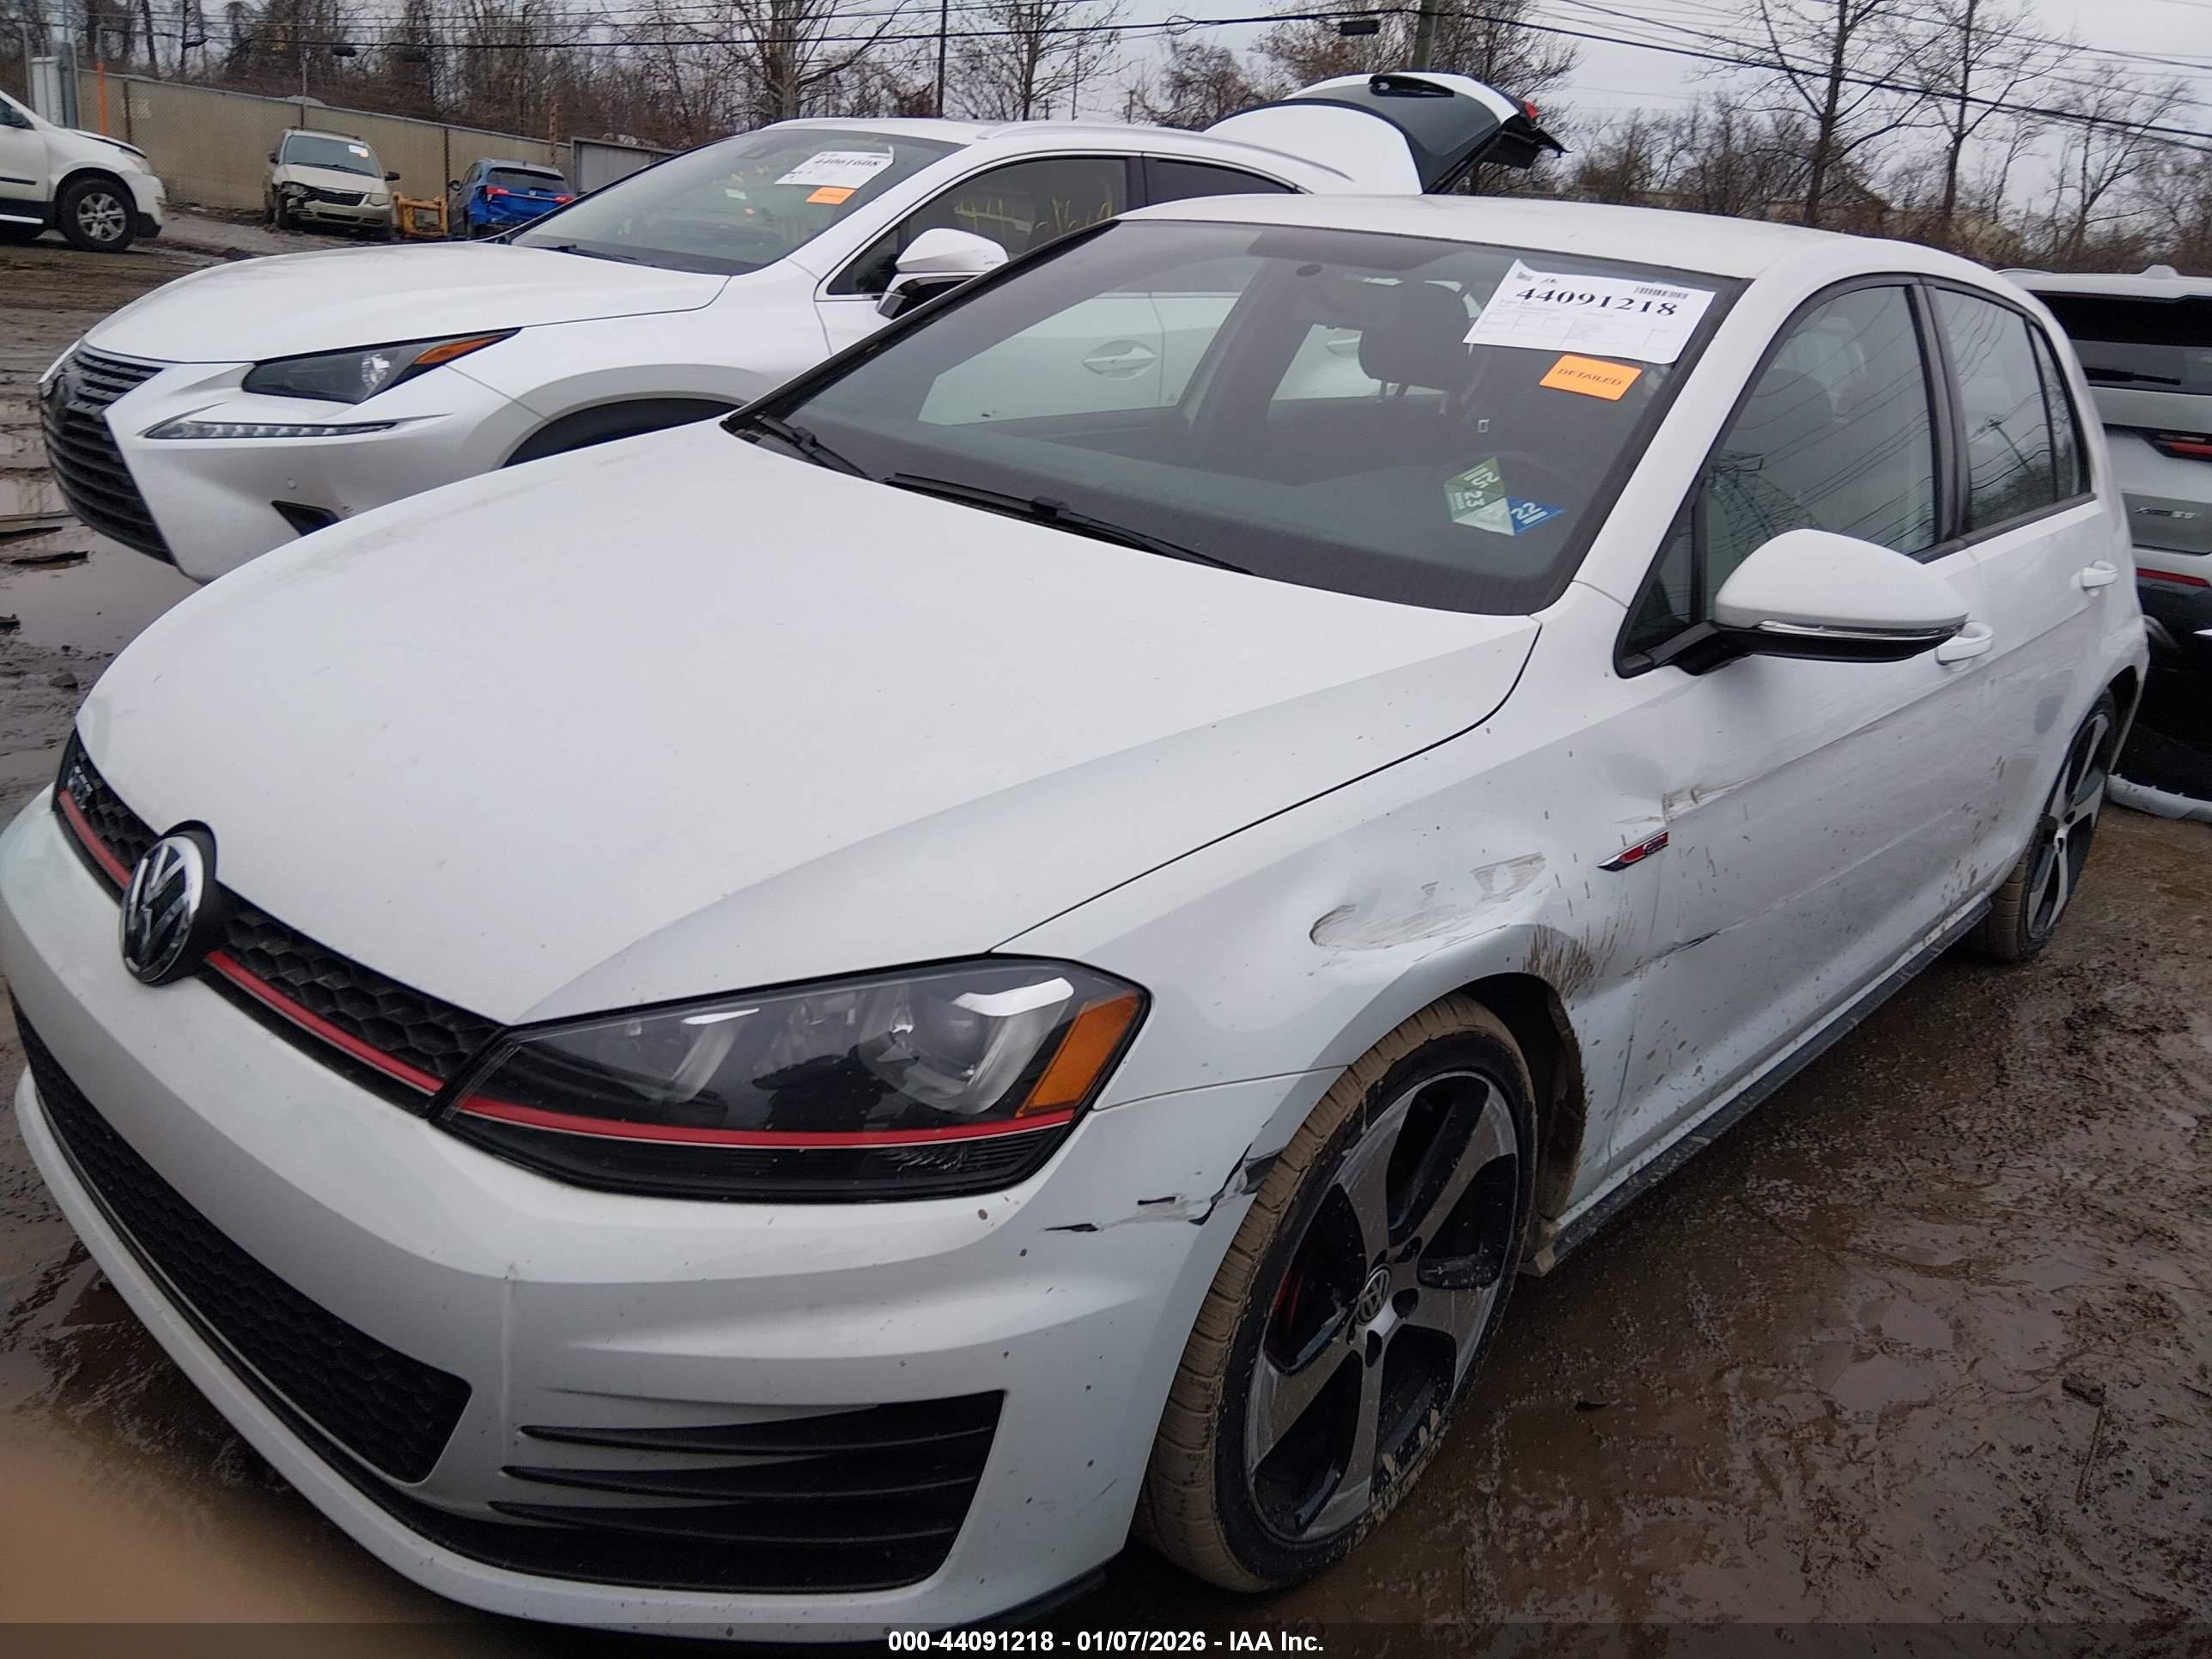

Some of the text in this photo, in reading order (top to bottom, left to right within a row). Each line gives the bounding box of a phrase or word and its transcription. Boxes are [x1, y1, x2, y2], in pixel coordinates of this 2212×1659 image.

[1516, 287, 1678, 316] 44091218
[1557, 368, 1622, 386] DETAILED
[1464, 490, 1486, 507] 23
[1510, 501, 1543, 520] 22
